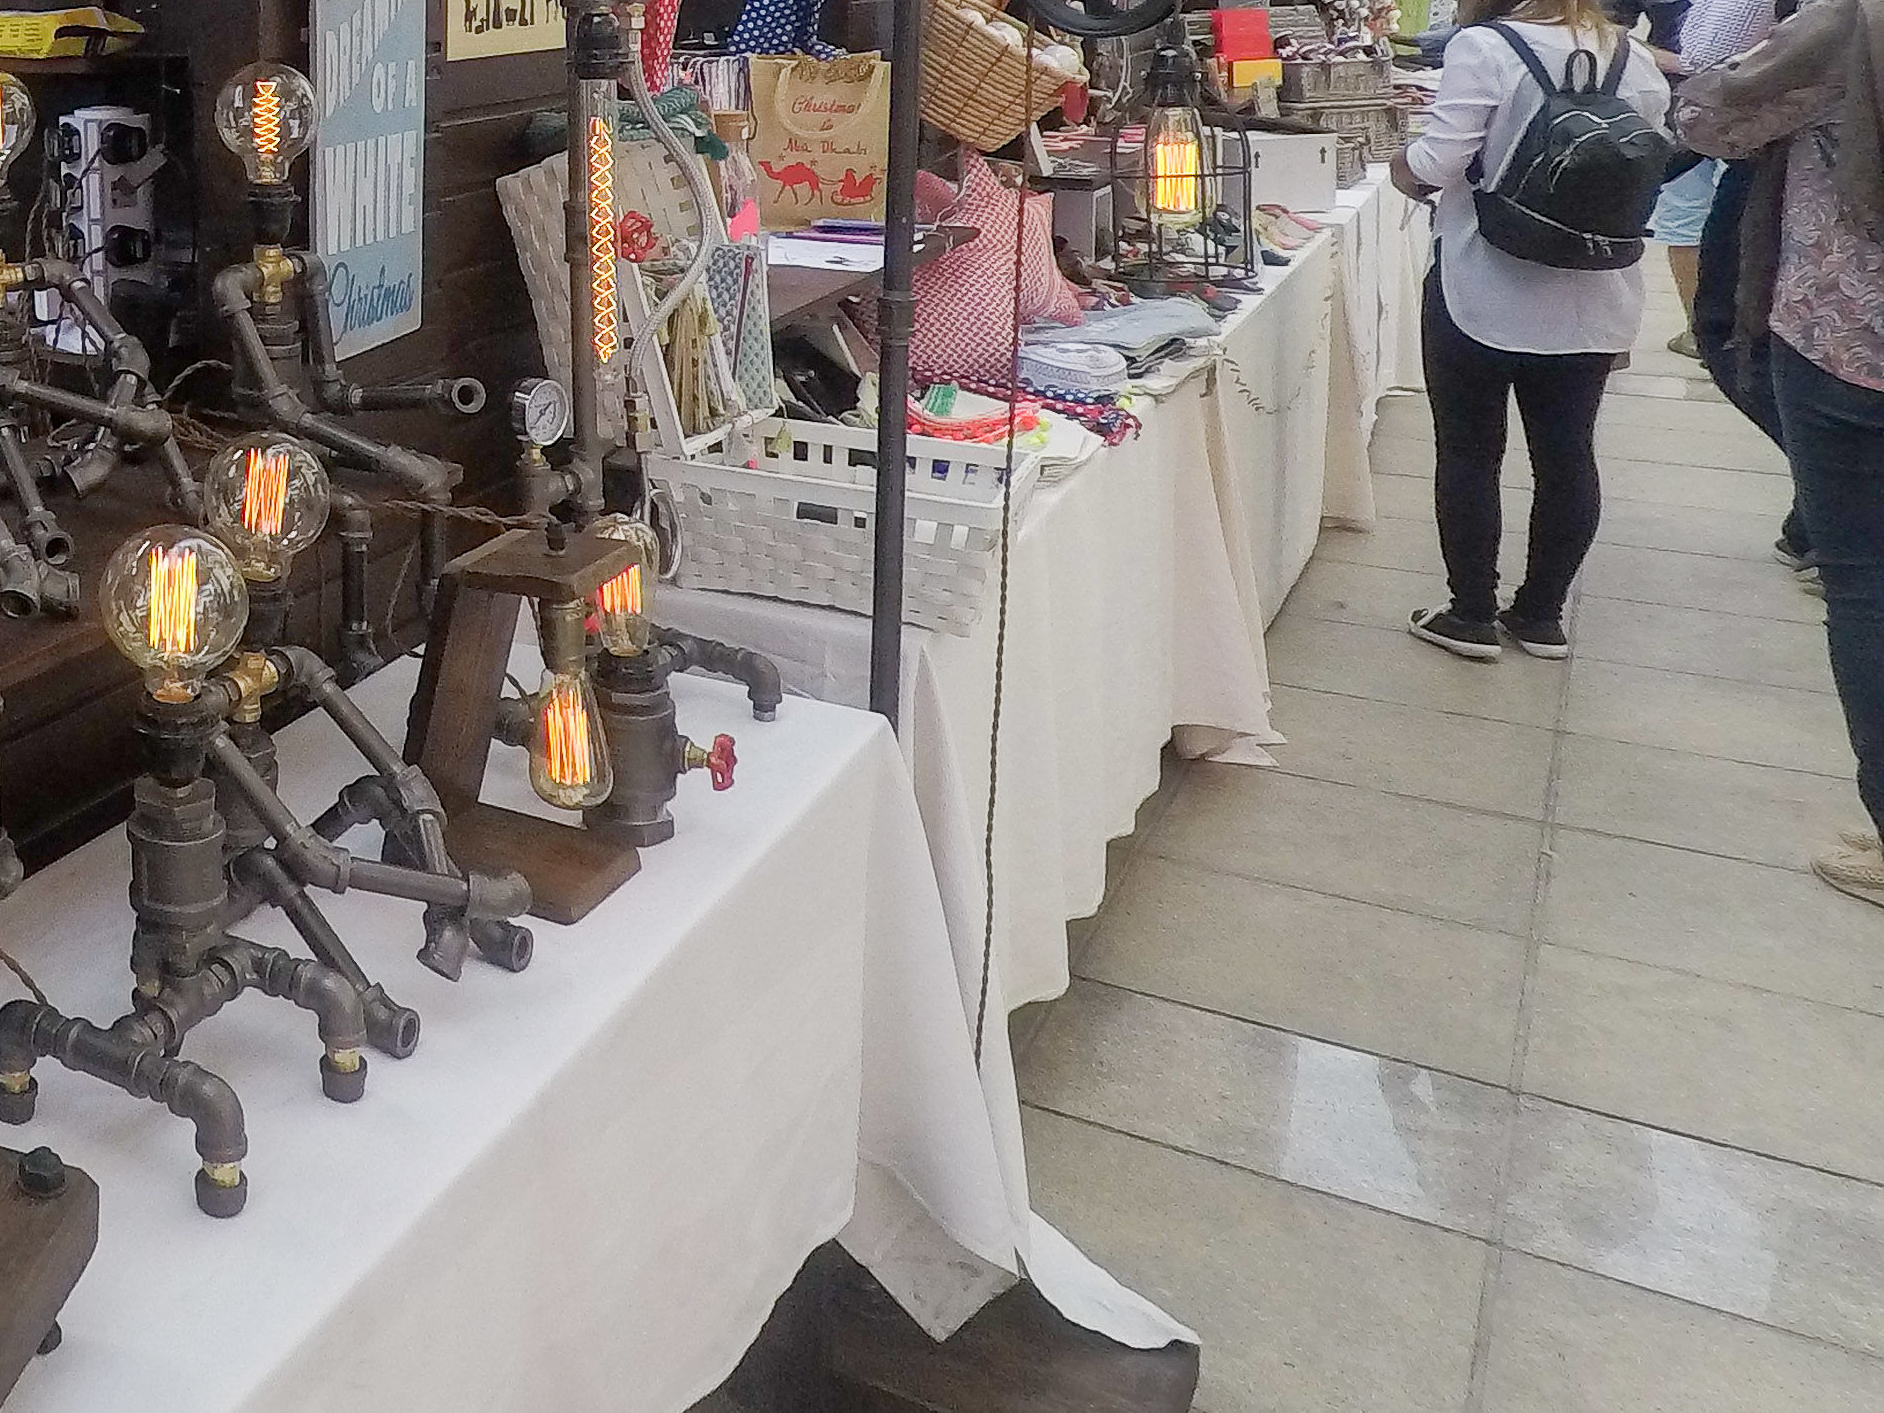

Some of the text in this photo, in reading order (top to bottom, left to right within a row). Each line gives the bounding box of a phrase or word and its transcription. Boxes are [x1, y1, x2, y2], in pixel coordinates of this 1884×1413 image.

[371, 59, 417, 114] OF A
[324, 130, 418, 256] WHITE
[328, 262, 415, 346] Christmas
